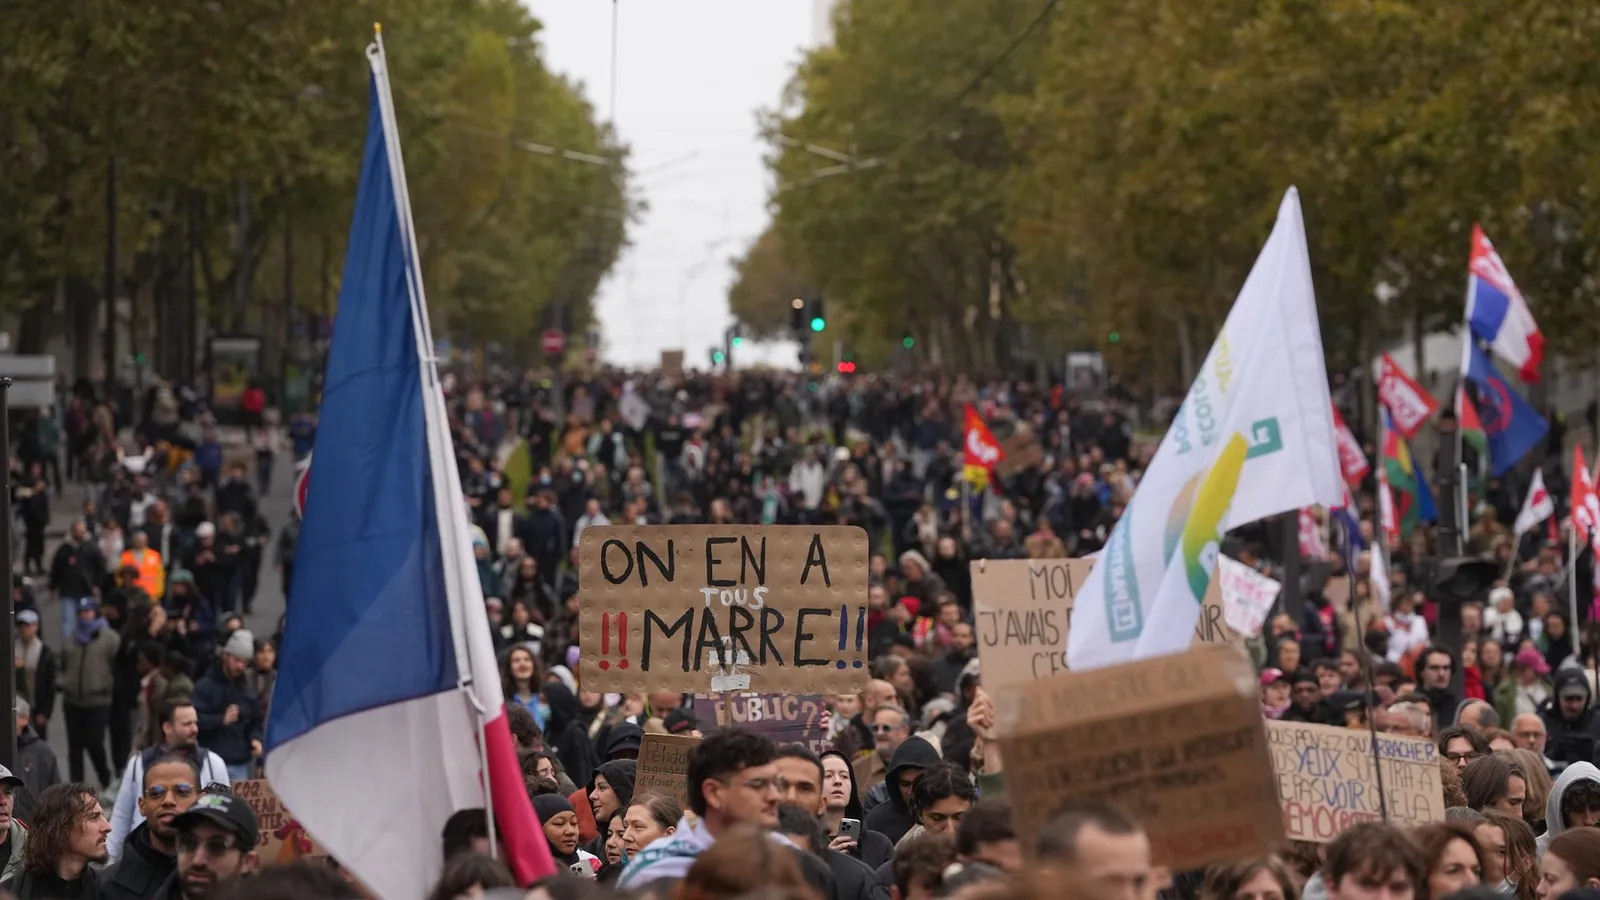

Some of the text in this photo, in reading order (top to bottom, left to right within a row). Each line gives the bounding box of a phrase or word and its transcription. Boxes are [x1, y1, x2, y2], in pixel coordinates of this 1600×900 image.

[600, 533, 831, 588] ON EN A
[699, 586, 770, 610] TOUS
[979, 608, 1061, 647] J'AVAIS
[645, 740, 689, 765] Penda
[1293, 743, 1342, 780] YEUX
[1276, 773, 1294, 801] E
[1292, 773, 1324, 805] PAS
[1322, 779, 1368, 813] VOIR
